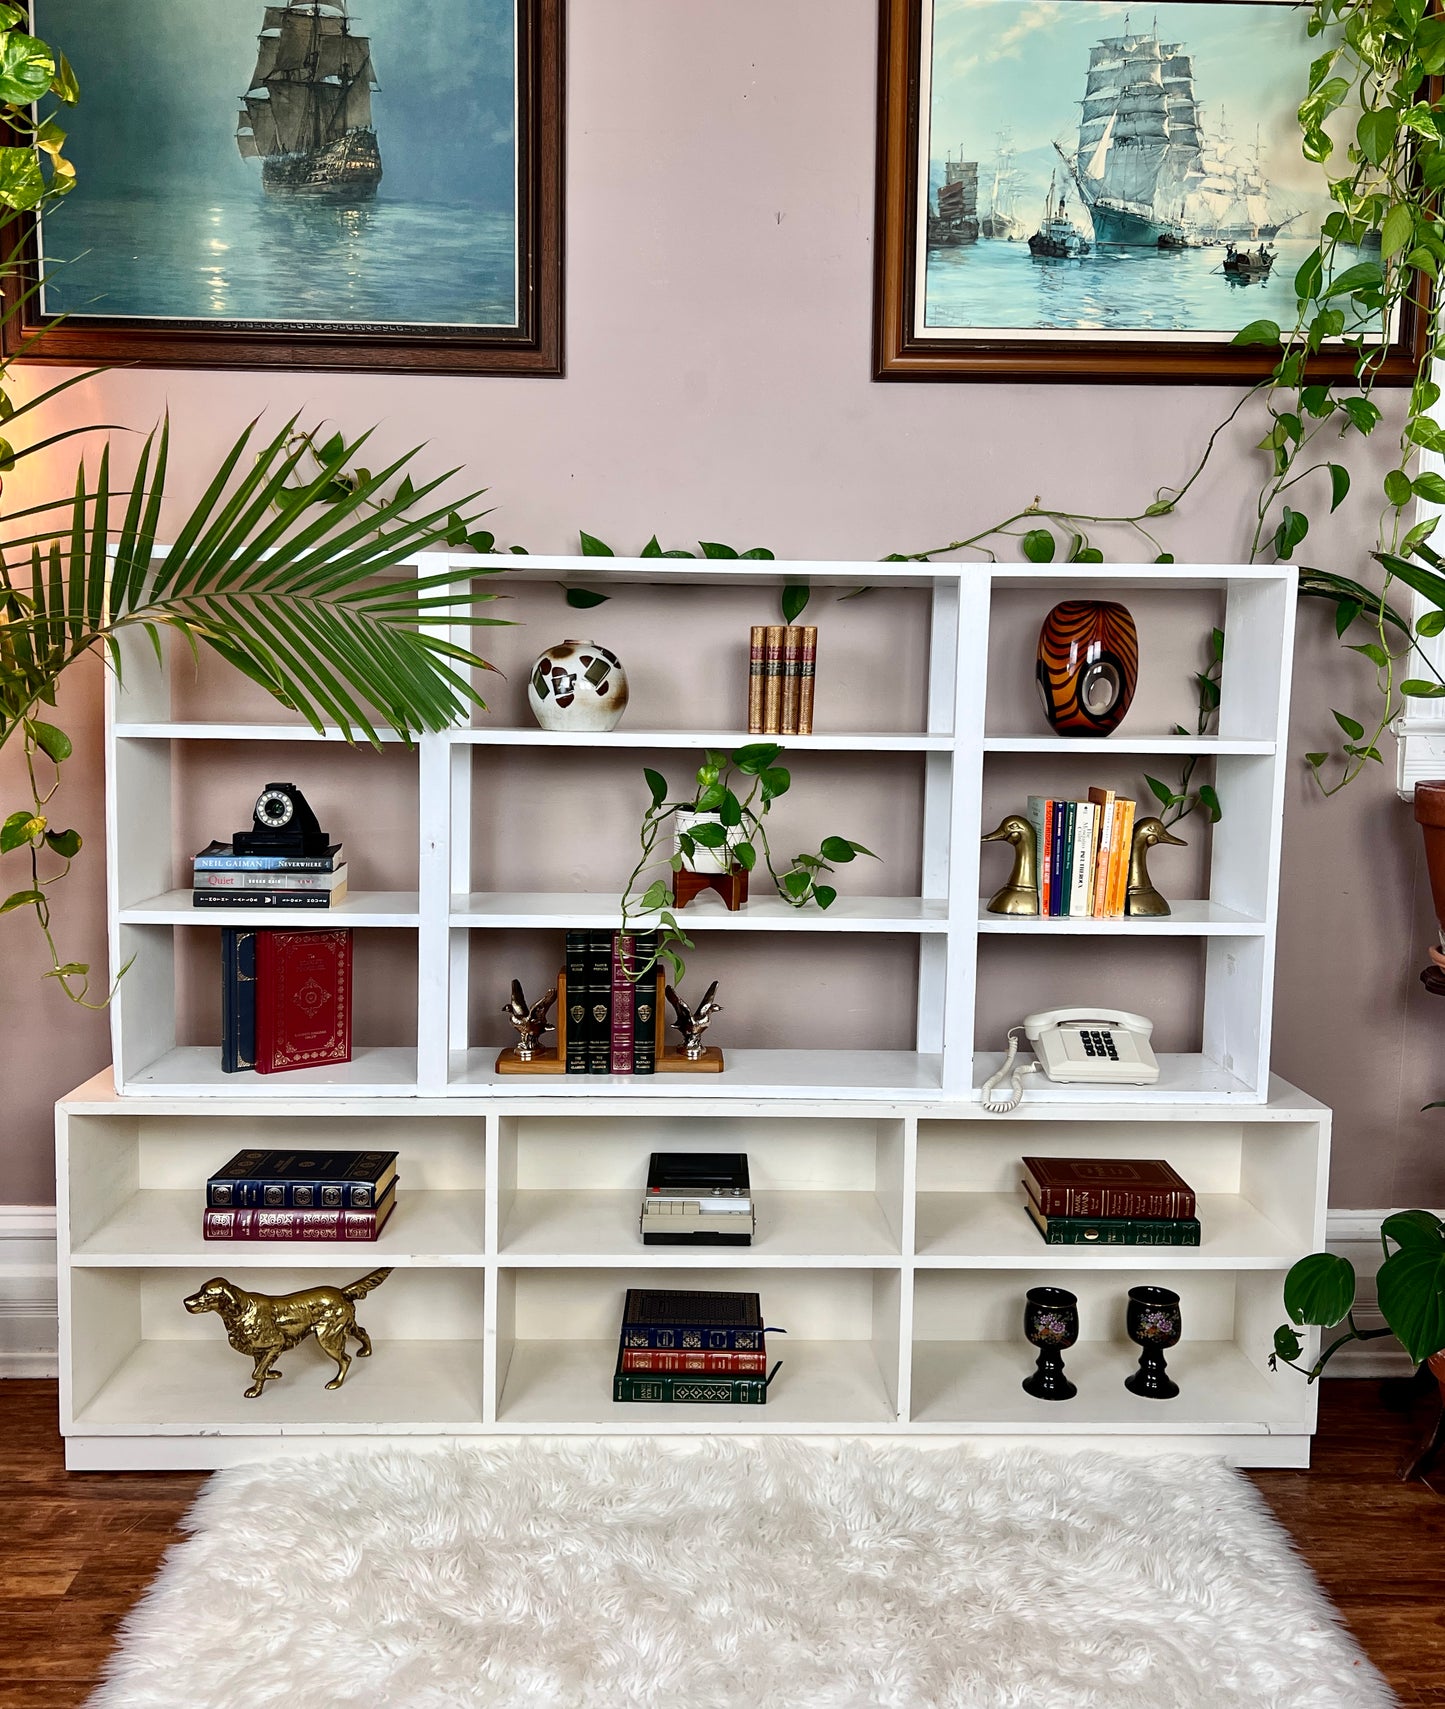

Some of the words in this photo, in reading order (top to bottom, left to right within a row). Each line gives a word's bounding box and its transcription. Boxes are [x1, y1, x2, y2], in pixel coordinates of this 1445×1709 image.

[278, 860, 322, 868] NEVERWHERE
[208, 873, 235, 886] Quiet
[1074, 1194, 1082, 1213] MARK
[1081, 1191, 1089, 1215] TWAIN
